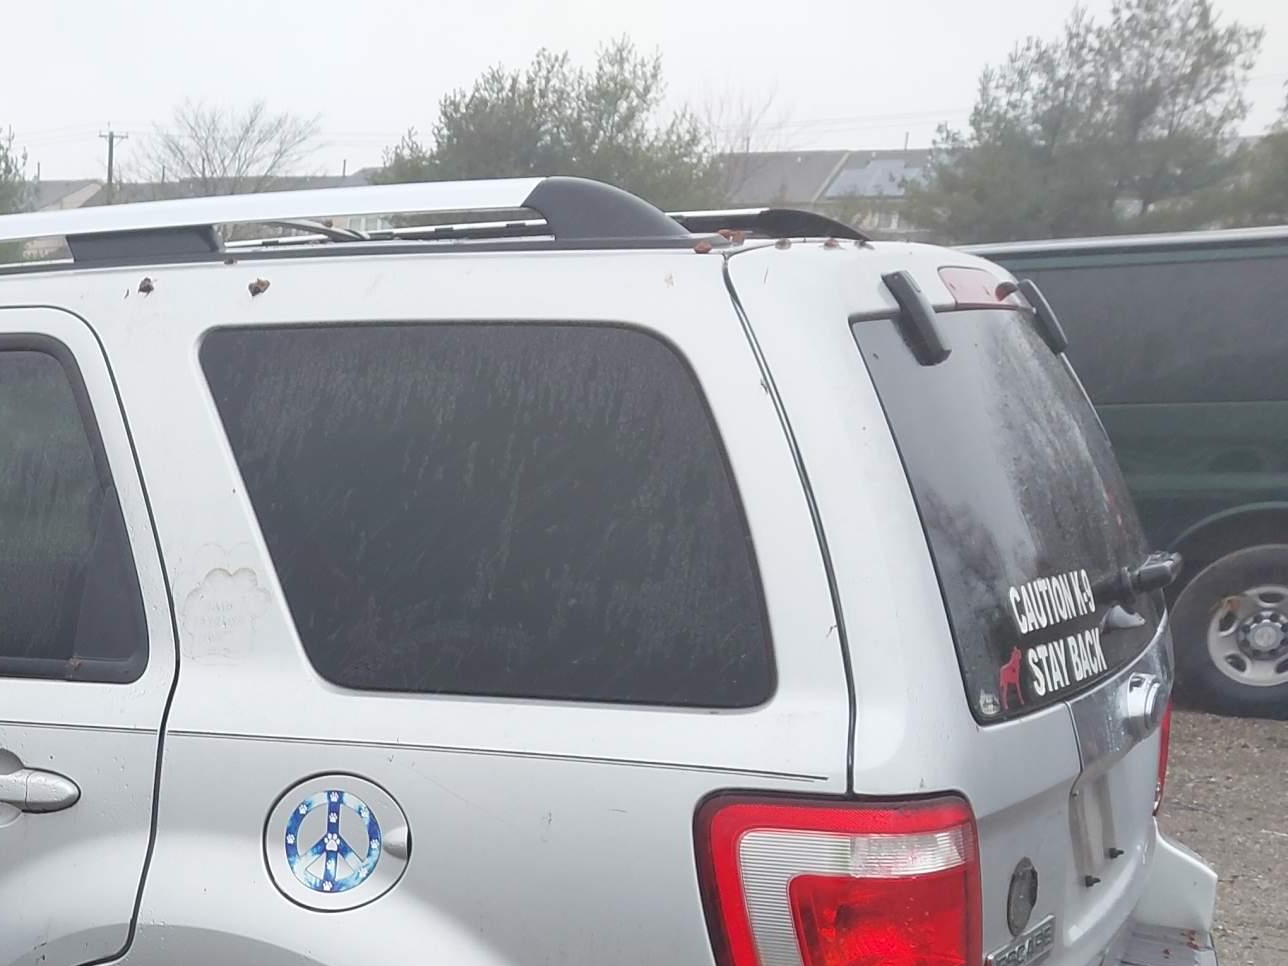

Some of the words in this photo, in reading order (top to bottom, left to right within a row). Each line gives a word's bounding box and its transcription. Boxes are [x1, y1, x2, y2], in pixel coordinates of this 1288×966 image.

[1009, 573, 1077, 634] CAUTION
[1068, 569, 1096, 616] K-9
[1028, 639, 1070, 696] STAY
[1067, 627, 1108, 682] BACK
